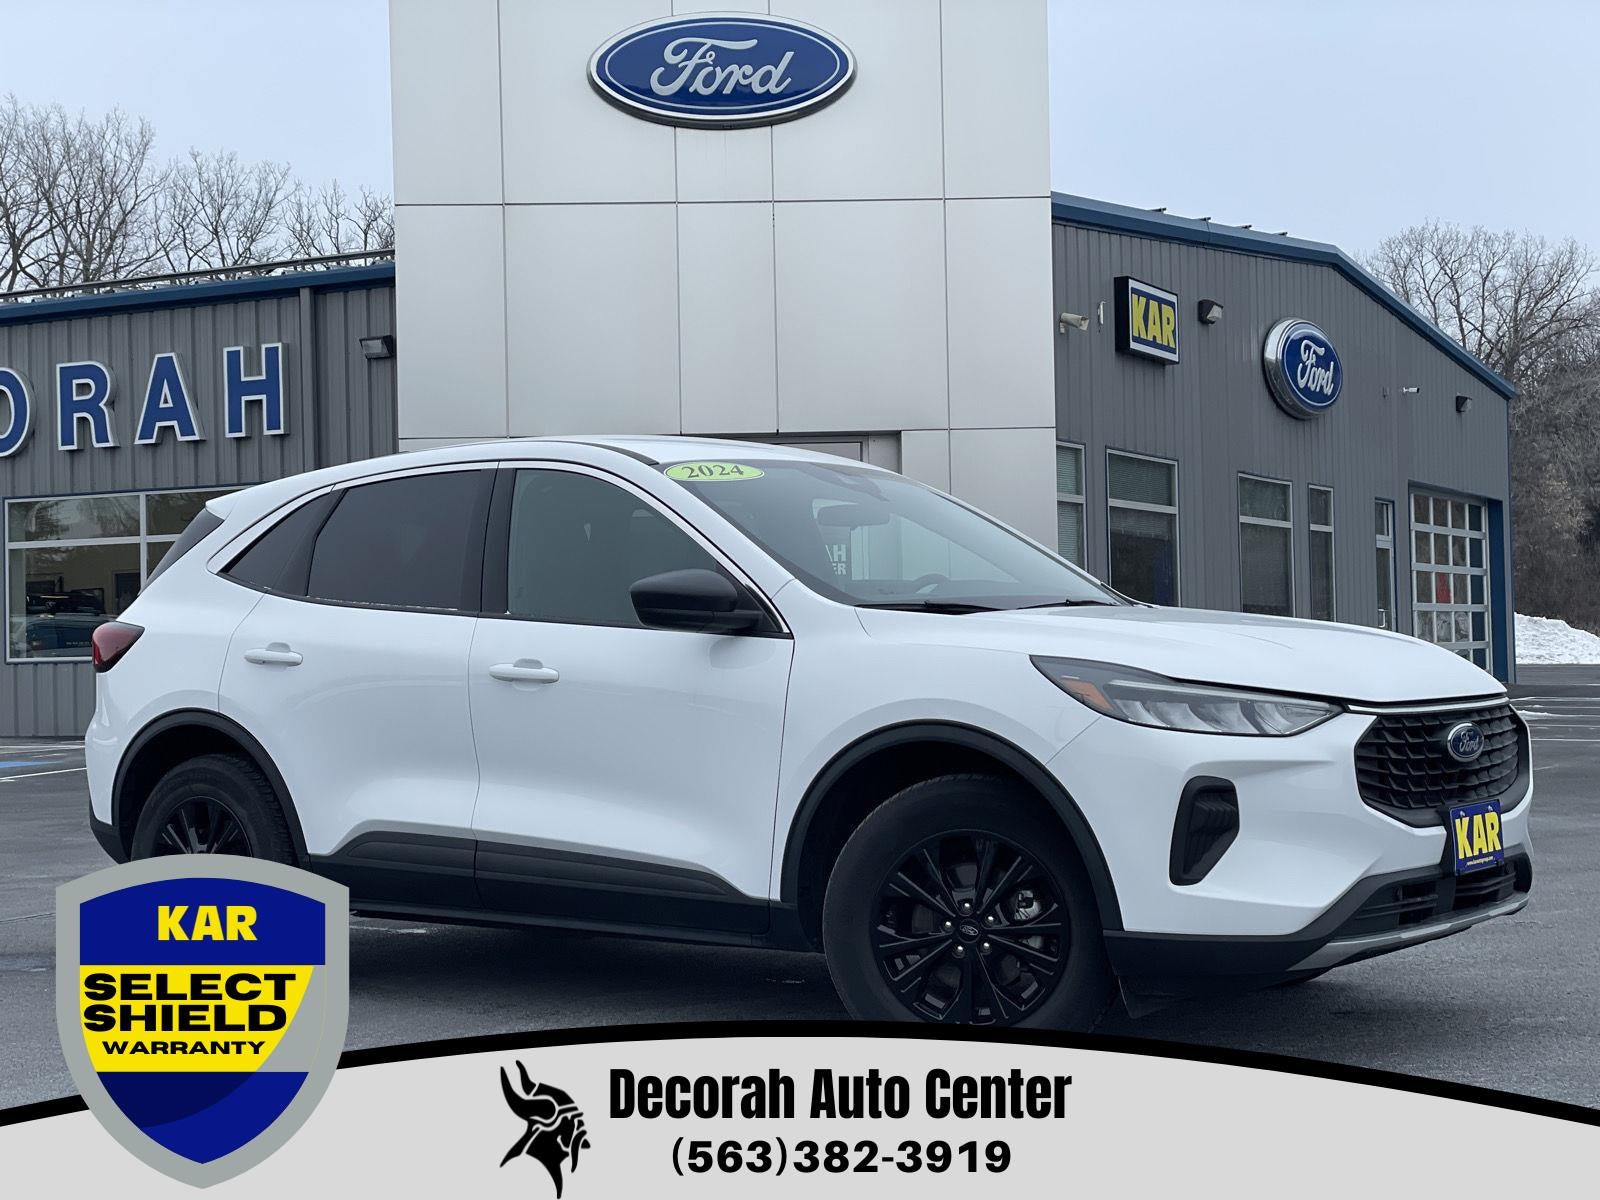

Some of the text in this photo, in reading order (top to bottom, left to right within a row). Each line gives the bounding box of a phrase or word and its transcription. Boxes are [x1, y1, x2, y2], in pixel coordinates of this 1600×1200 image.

[650, 37, 794, 96] Ford
[1132, 293, 1176, 348] KAR
[1297, 339, 1334, 395] Ford
[681, 464, 745, 478] 2024
[1455, 811, 1501, 859] KAR
